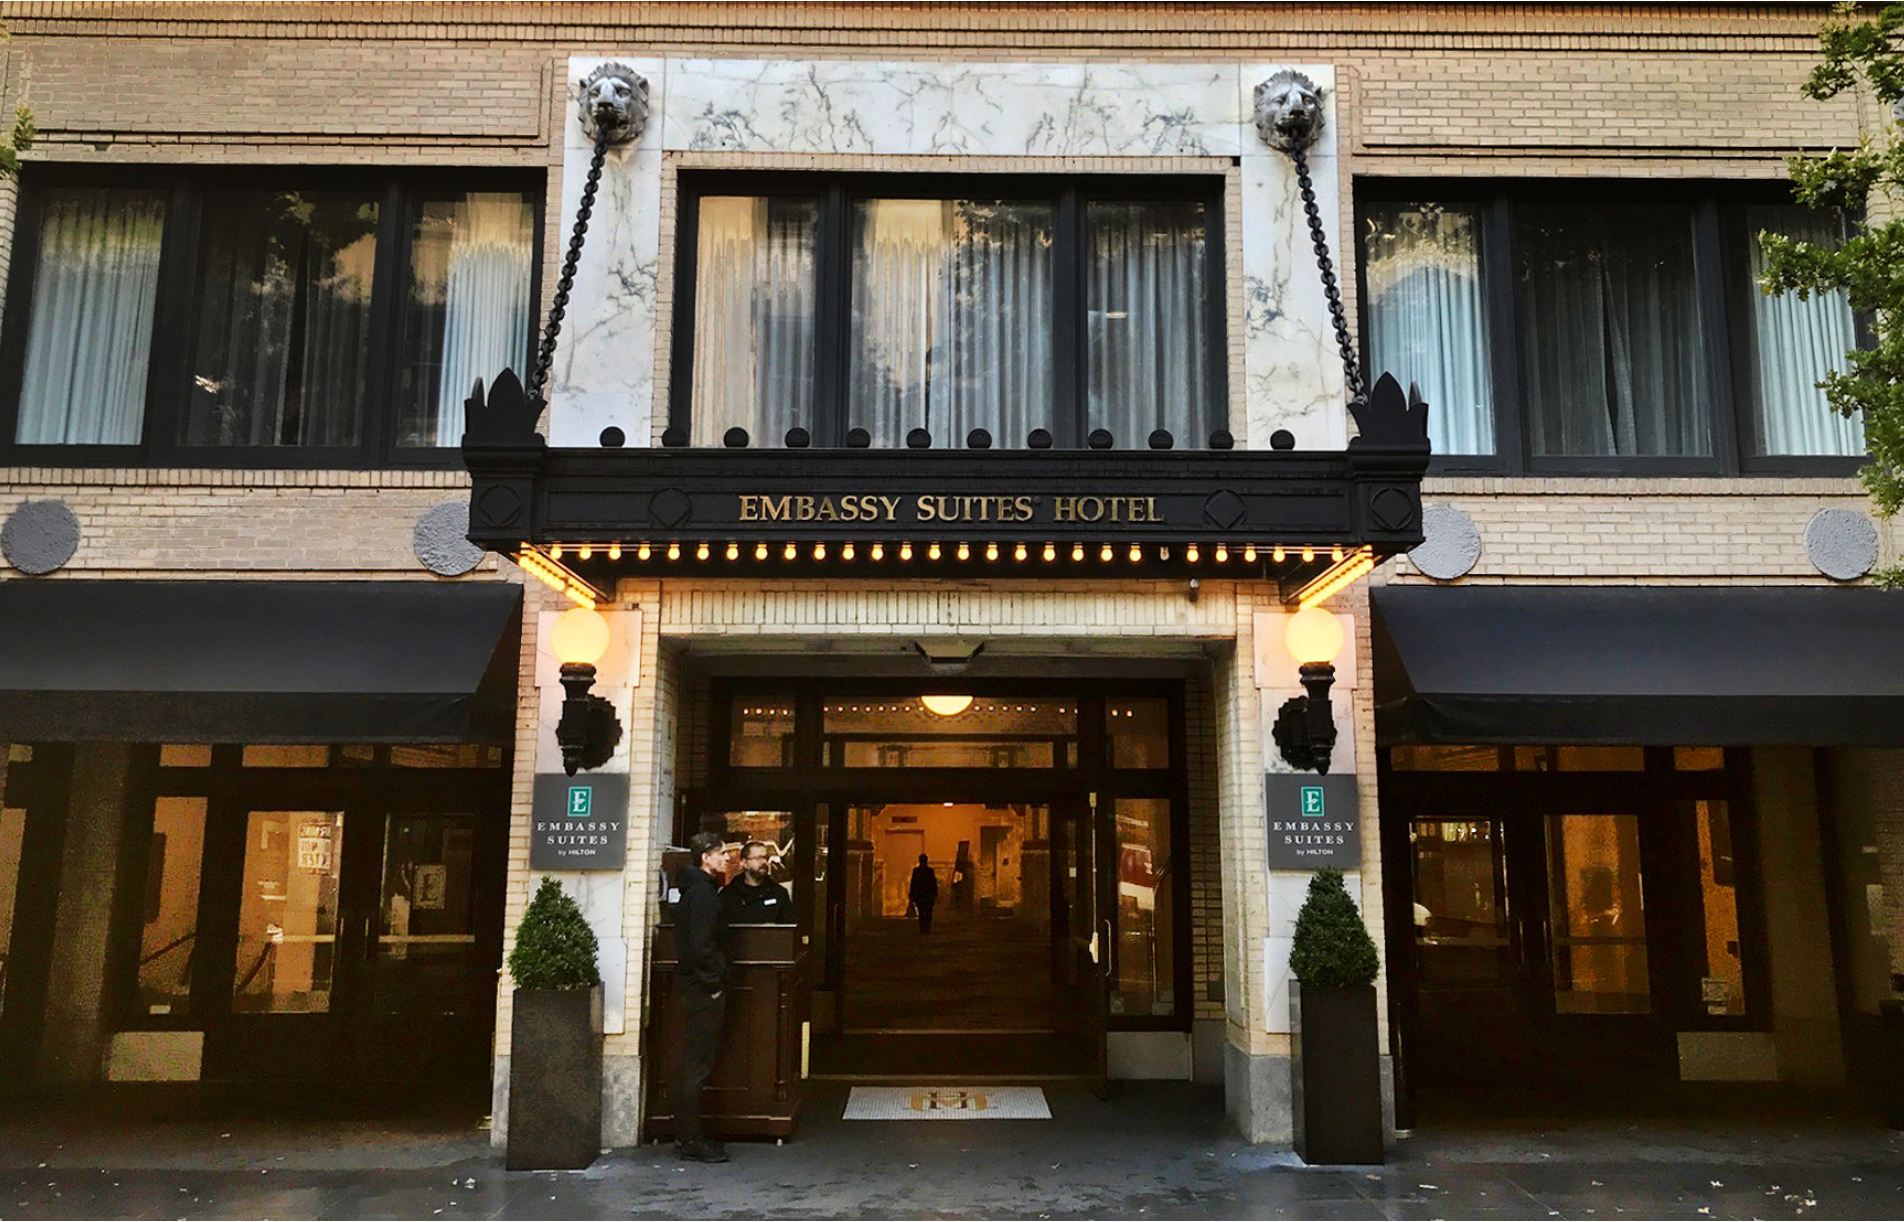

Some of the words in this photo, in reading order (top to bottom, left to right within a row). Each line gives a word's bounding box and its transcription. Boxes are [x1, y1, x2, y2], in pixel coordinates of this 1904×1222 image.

[739, 495, 901, 521] EMBASSY
[917, 495, 1034, 521] SUITES
[1053, 496, 1165, 522] HOTEL
[571, 789, 588, 813] E
[1304, 789, 1321, 813] E
[537, 821, 620, 831] EMBASSY
[1273, 821, 1354, 831] EMBASSY
[547, 835, 608, 845] SUITES
[1284, 834, 1344, 844] SUITES
